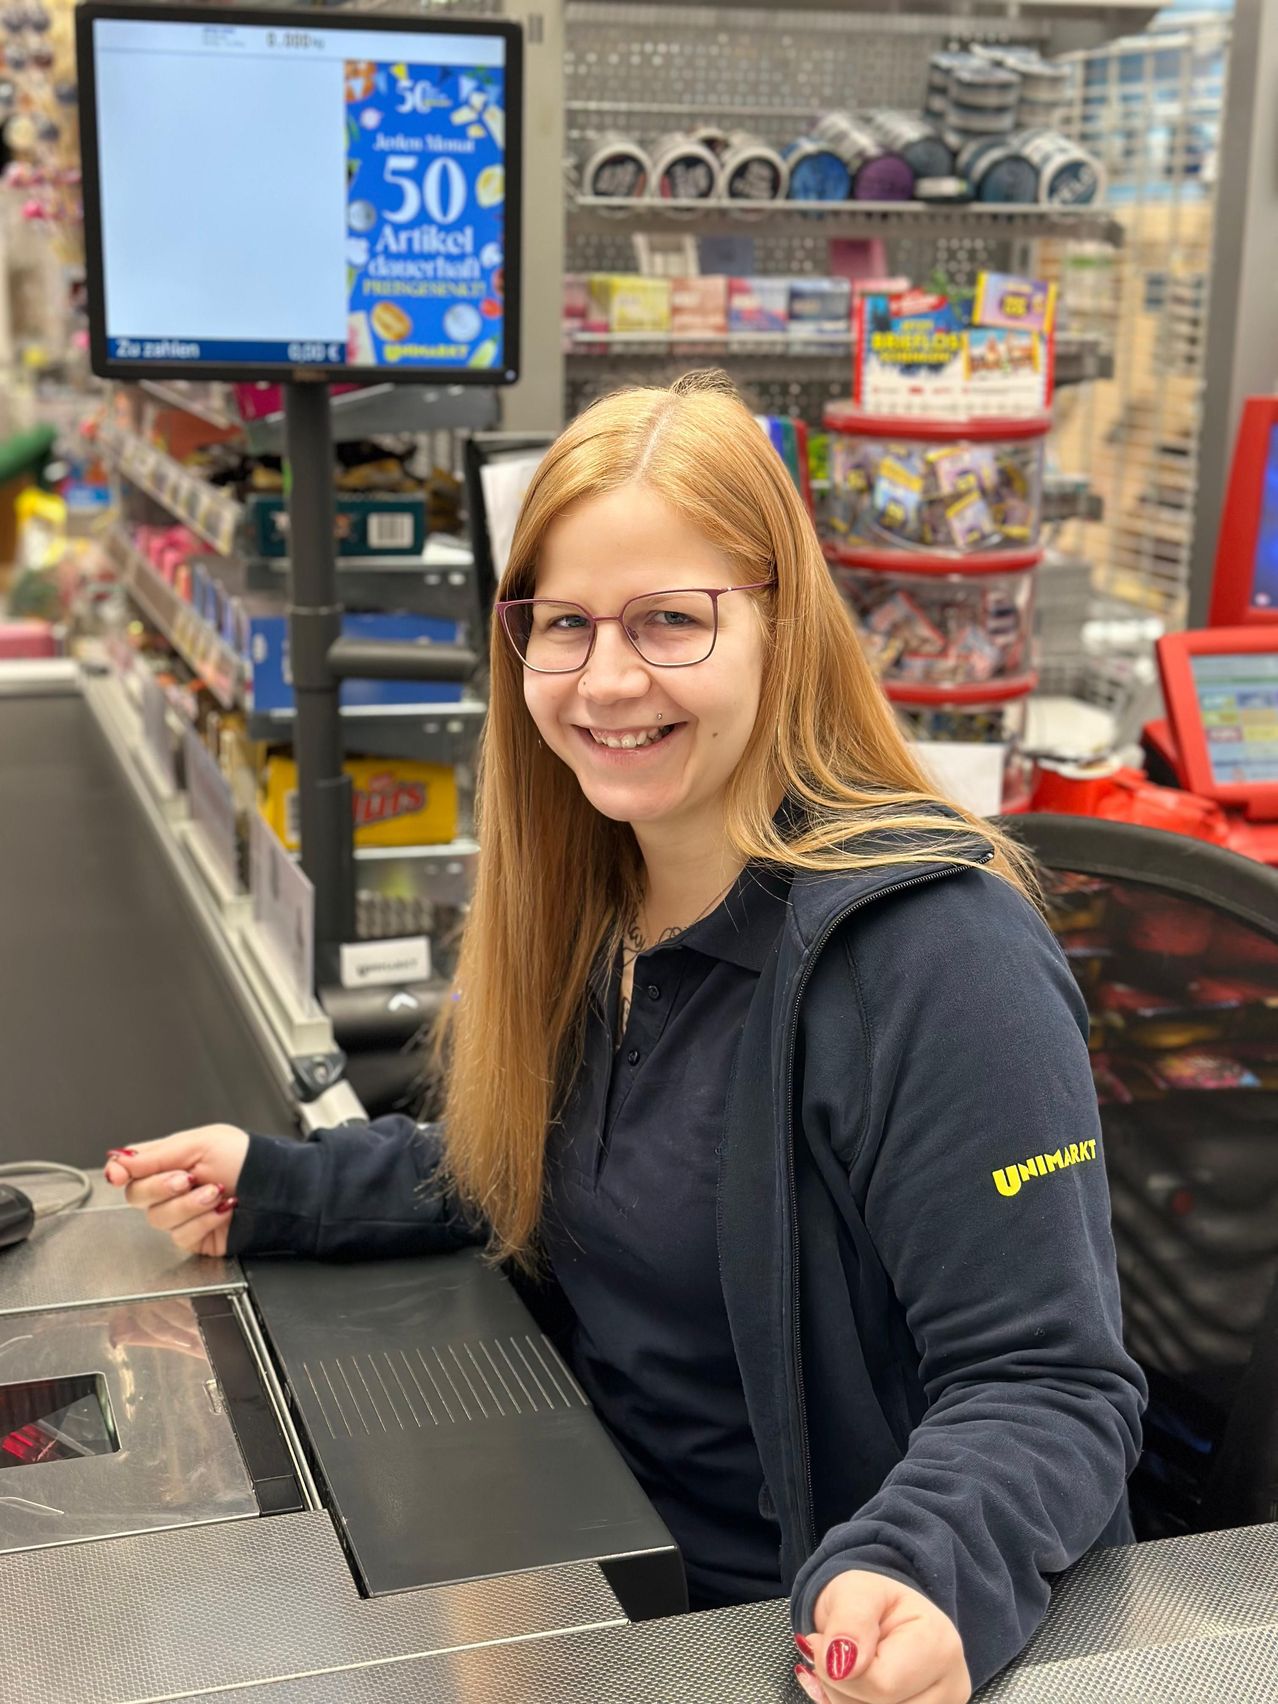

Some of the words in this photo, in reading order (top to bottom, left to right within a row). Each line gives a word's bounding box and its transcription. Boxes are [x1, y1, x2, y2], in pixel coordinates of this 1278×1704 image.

[373, 132, 423, 152] Jeden
[425, 134, 476, 154] Monat
[381, 155, 467, 225] 50
[375, 223, 474, 255] Artikel
[368, 254, 481, 280] dauerhaft
[115, 339, 141, 358] Zu
[142, 340, 200, 360] zahlen
[287, 343, 325, 363] 0,00
[327, 344, 340, 362] €
[992, 1139, 1096, 1196] UNIMARKT
